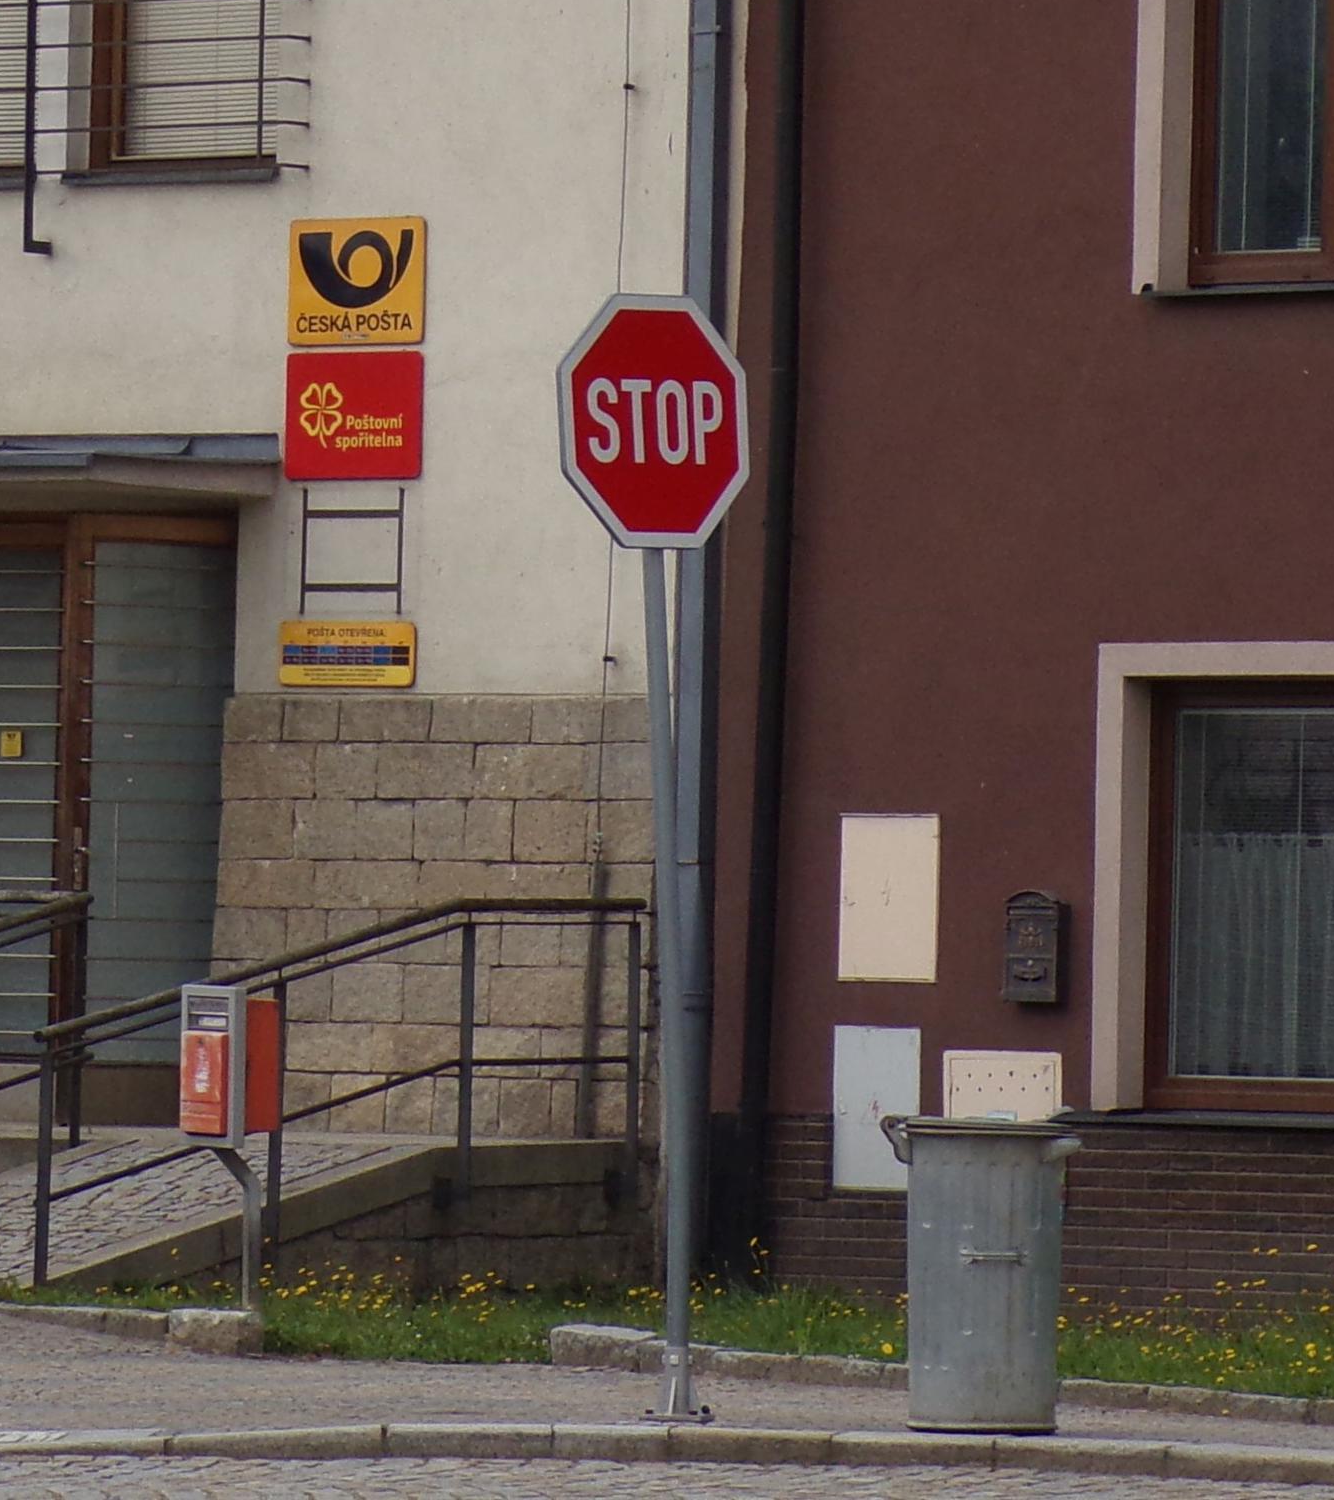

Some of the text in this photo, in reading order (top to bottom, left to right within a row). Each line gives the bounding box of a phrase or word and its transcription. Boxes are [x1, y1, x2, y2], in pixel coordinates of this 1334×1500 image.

[296, 310, 413, 333] ČESKÁ POŠTA
[346, 413, 403, 430] Poštovní
[586, 377, 723, 465] STOP
[335, 431, 403, 451] spořitelna
[306, 626, 335, 638] POŠTA
